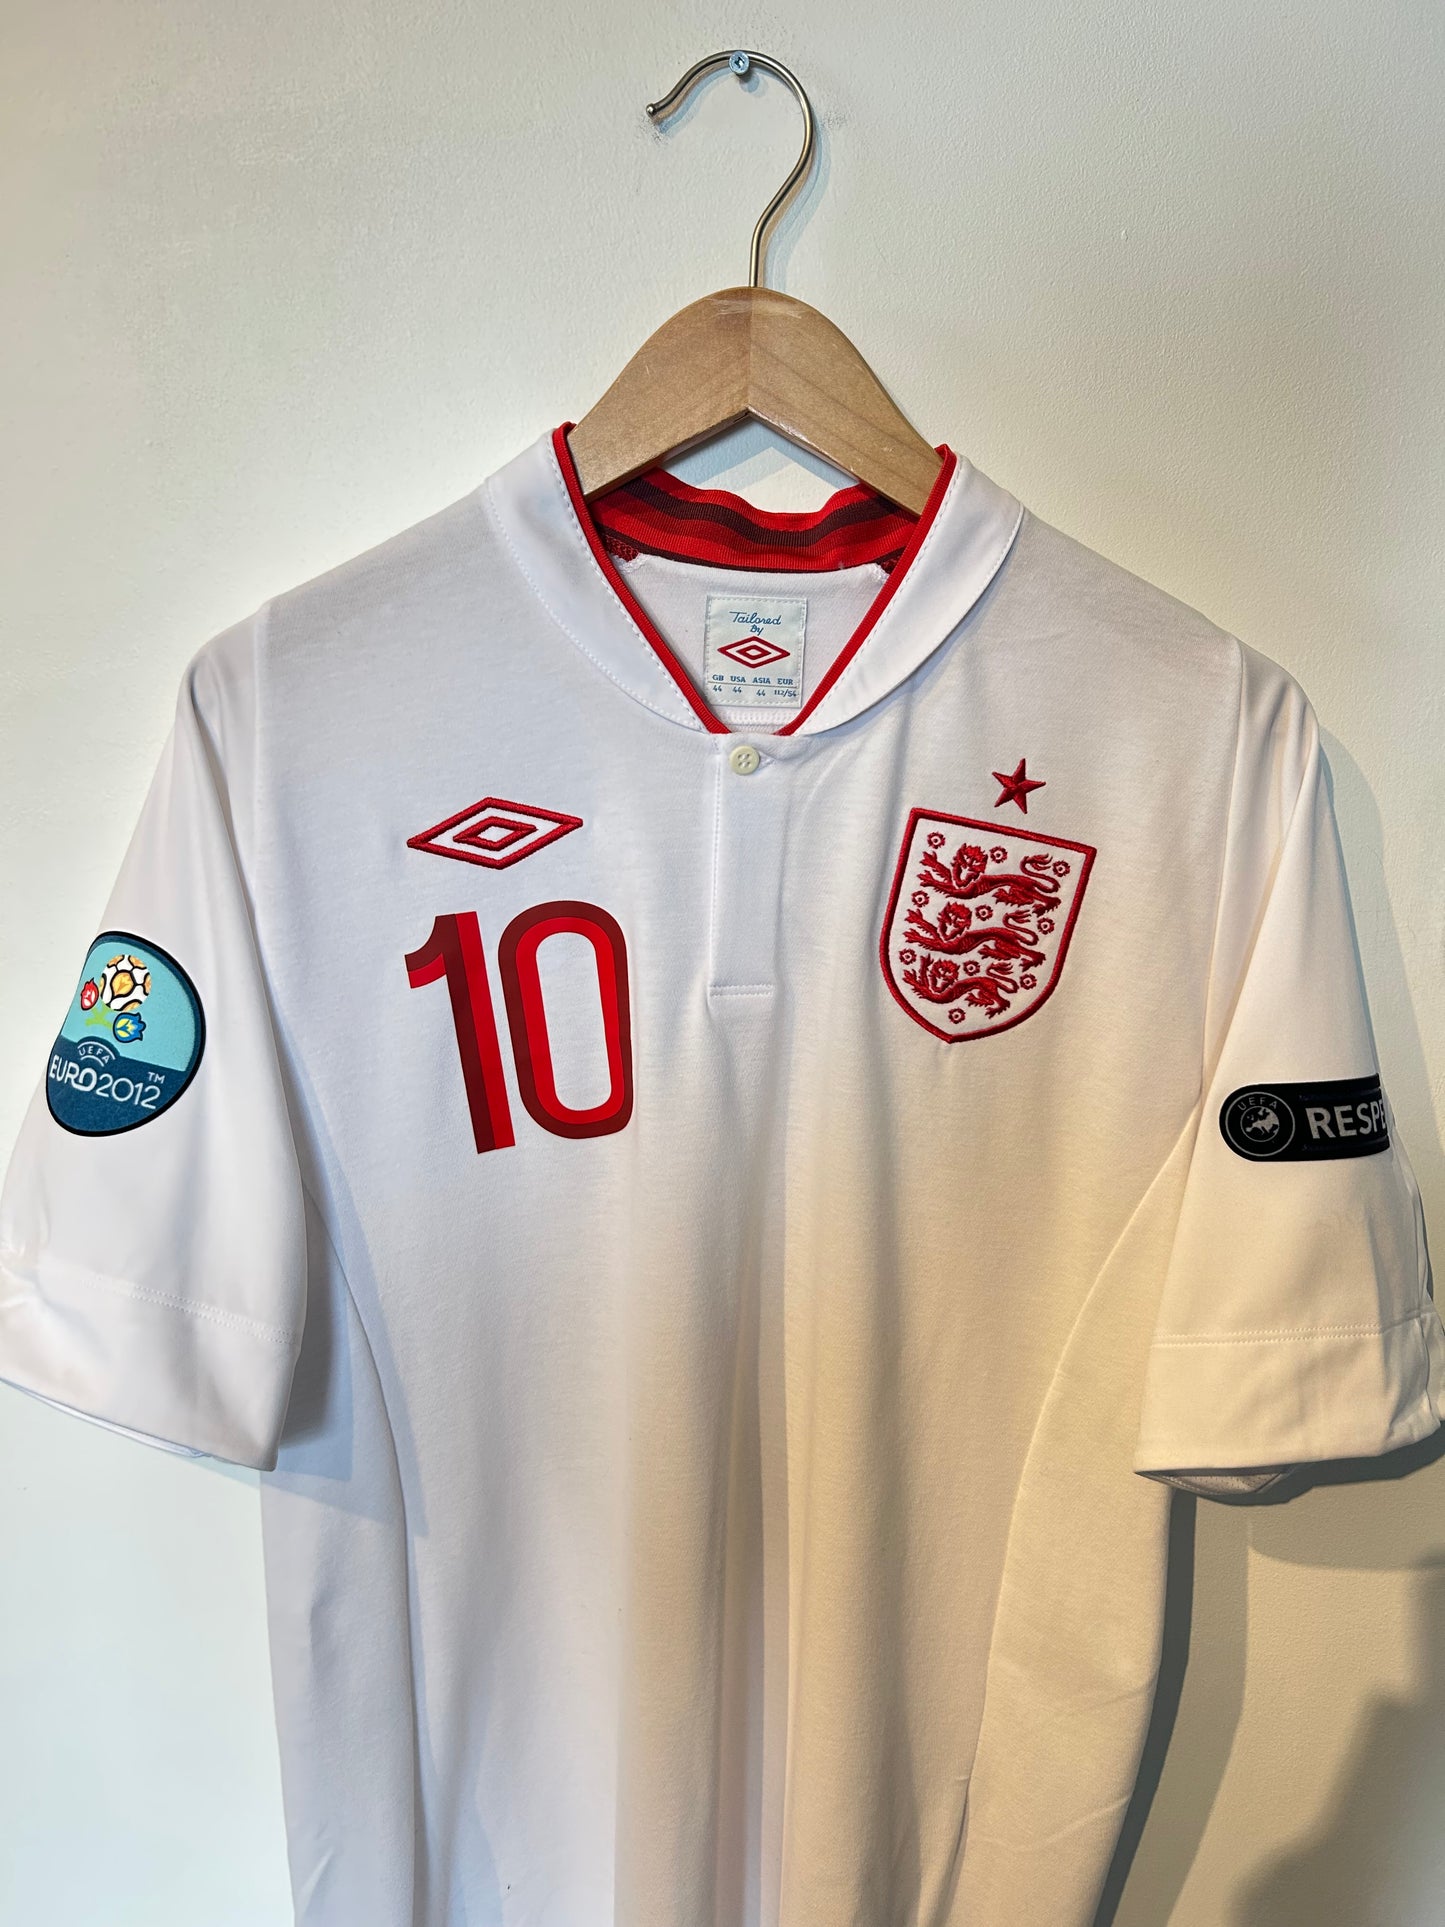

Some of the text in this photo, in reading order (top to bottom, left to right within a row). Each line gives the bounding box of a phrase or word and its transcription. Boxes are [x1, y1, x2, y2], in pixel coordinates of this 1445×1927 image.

[729, 611, 782, 625] Tailored
[712, 674, 794, 686] GB USA ASIA EUR
[774, 689, 797, 697] 112/54
[404, 900, 633, 1154] 10
[79, 1046, 110, 1064] UEFA
[1237, 1096, 1278, 1111] UEFA
